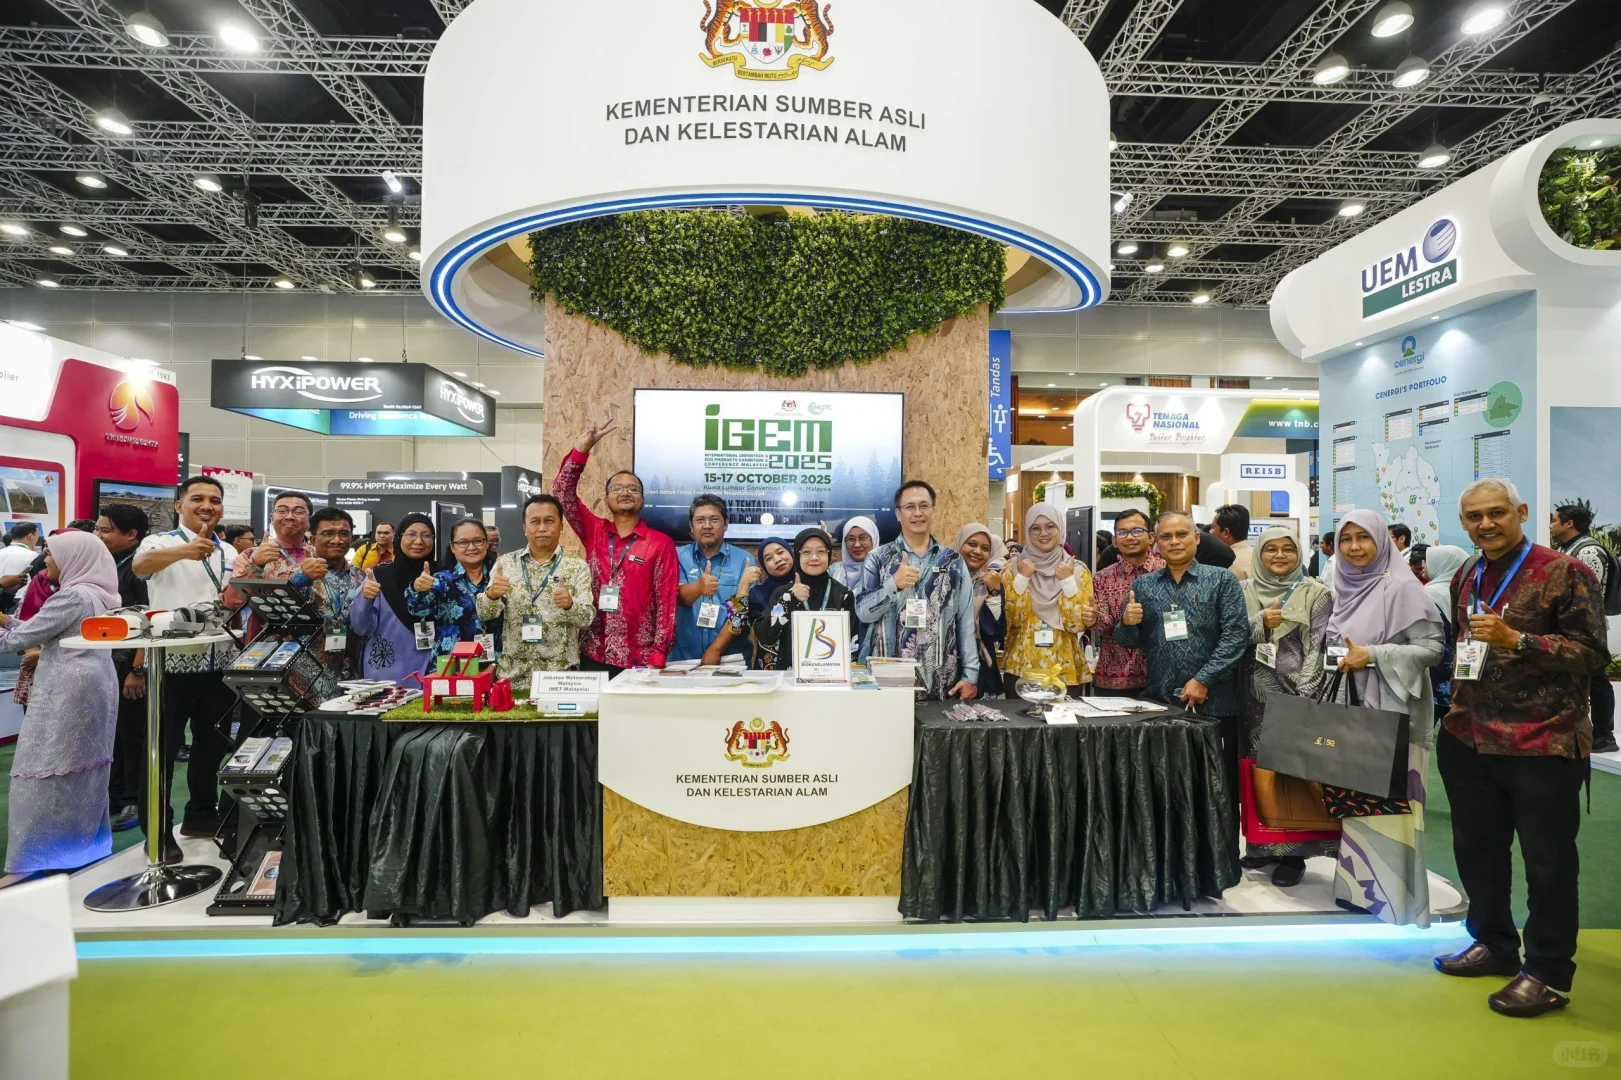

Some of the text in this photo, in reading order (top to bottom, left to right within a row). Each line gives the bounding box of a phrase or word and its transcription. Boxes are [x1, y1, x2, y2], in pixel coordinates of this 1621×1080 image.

[606, 94, 926, 130] KEMENTERIAN SUMBER ASLI
[624, 121, 907, 153] DAN KELESTARIAN ALAM
[1361, 245, 1418, 293] UEM
[1401, 266, 1453, 299] LESTRA
[1393, 351, 1425, 369] cenergi
[989, 356, 1001, 398] Tandas
[1375, 375, 1448, 400] CENERGI'S PORTFOLIO
[349, 411, 377, 421] Driving
[1152, 412, 1189, 421] TENAGA
[1152, 420, 1200, 429] NASIONAL
[768, 454, 832, 470] 2025
[1245, 467, 1282, 475] REISB
[704, 473, 832, 485] 15-17 OCTOBER 2025
[340, 482, 363, 490] 99.9%
[425, 482, 447, 492] Every
[721, 484, 745, 492] Lumpur
[782, 500, 825, 514] EDULE
[676, 773, 839, 784] KEMENTERIAN SUMBER ASLI
[686, 787, 828, 797] DAN KELESTARIAN ALAM
